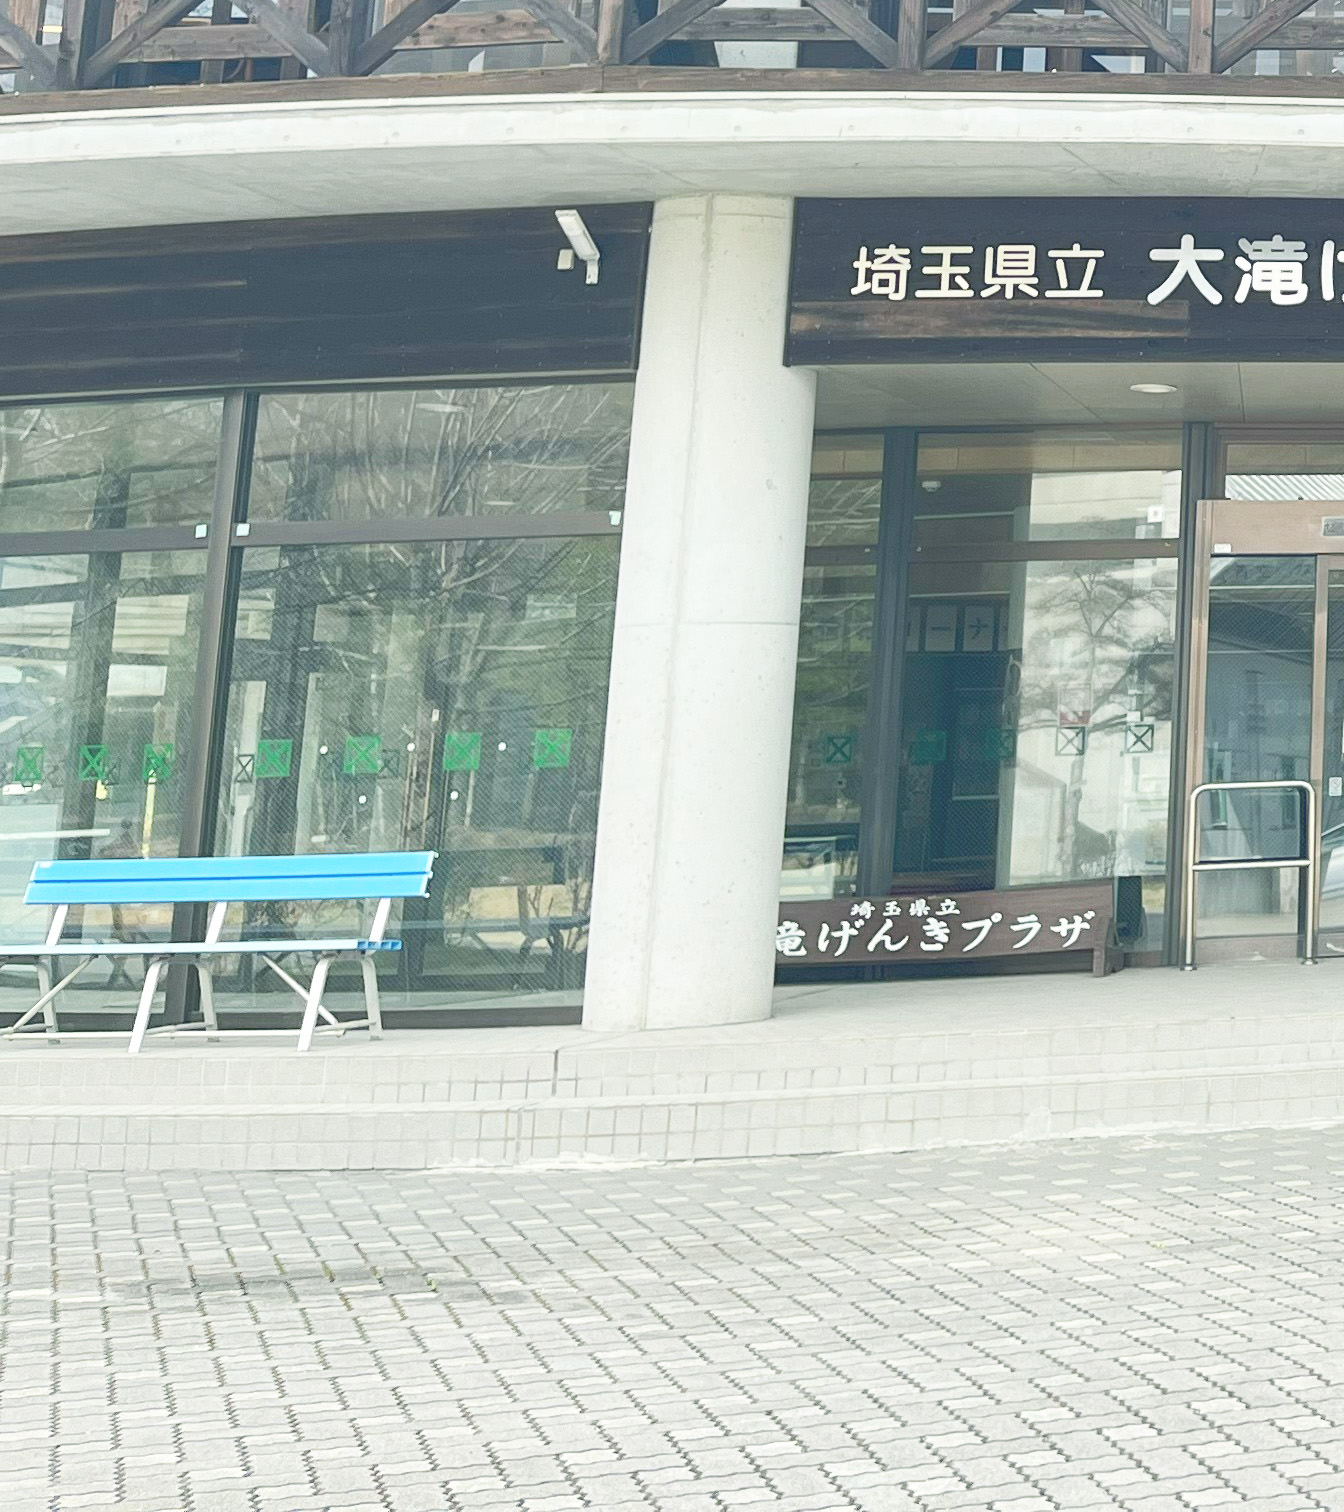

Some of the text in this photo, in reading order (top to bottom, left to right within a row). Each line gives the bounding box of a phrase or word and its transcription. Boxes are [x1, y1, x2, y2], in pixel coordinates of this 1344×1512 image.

[851, 244, 1105, 301] 埼玉県立
[850, 898, 961, 919] 埼玉県立
